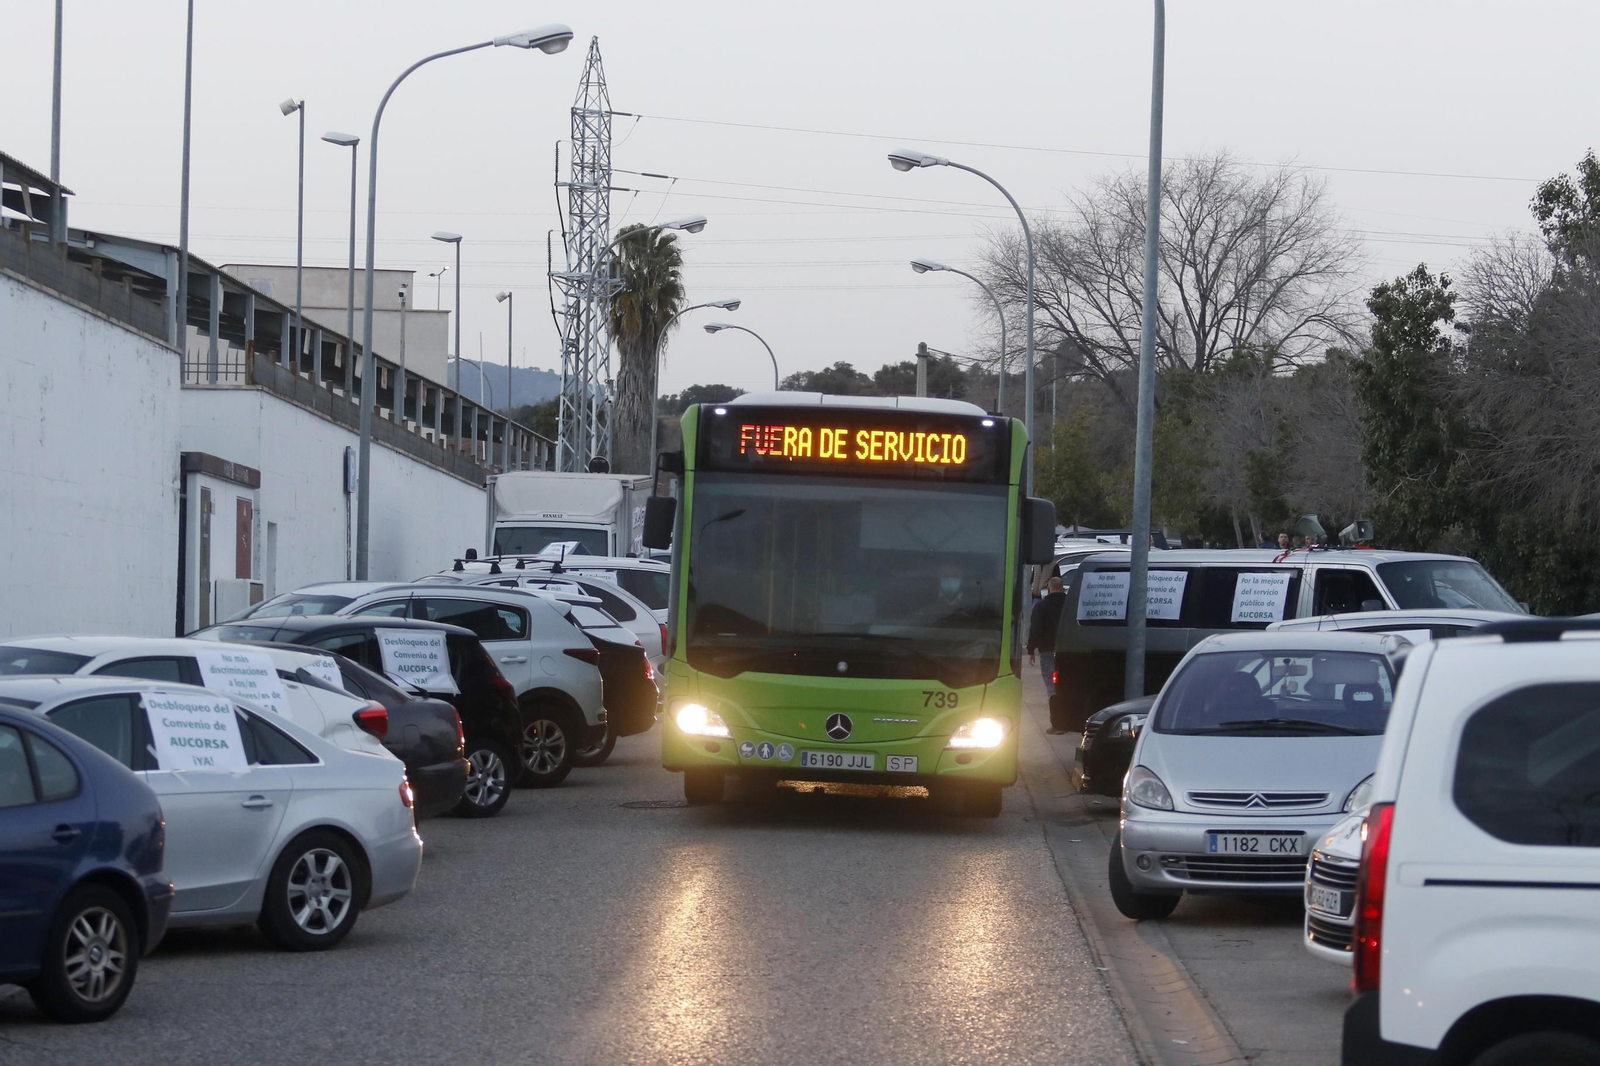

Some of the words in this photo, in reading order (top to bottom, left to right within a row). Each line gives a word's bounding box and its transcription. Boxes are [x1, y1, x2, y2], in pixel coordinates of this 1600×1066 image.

[741, 424, 812, 458] FUERA
[820, 428, 848, 459] DE
[855, 430, 966, 464] SERVICIO
[1260, 577, 1284, 586] mejora
[1253, 588, 1279, 596] servicio
[1238, 611, 1273, 619] AUCORSA
[384, 638, 428, 647] Desbloqueo
[429, 639, 441, 647] del
[221, 654, 233, 662] No
[393, 651, 427, 659] Convenio
[428, 652, 438, 660] de
[322, 660, 335, 669] del
[398, 664, 439, 673] AUCORSA
[209, 664, 268, 676] discriminaciones
[234, 678, 257, 688] los/as
[271, 690, 281, 700] de
[922, 691, 959, 709] 739
[149, 699, 211, 714] Desbloqueo
[213, 703, 230, 714] del
[162, 717, 211, 730] Convenio
[213, 720, 226, 731] de
[170, 736, 229, 749] AUCORSA
[193, 756, 215, 766] ¡YA!
[809, 753, 843, 767] 6190
[847, 755, 872, 769] JJL
[1223, 836, 1259, 852] 1182
[1269, 837, 1298, 853] CKX
